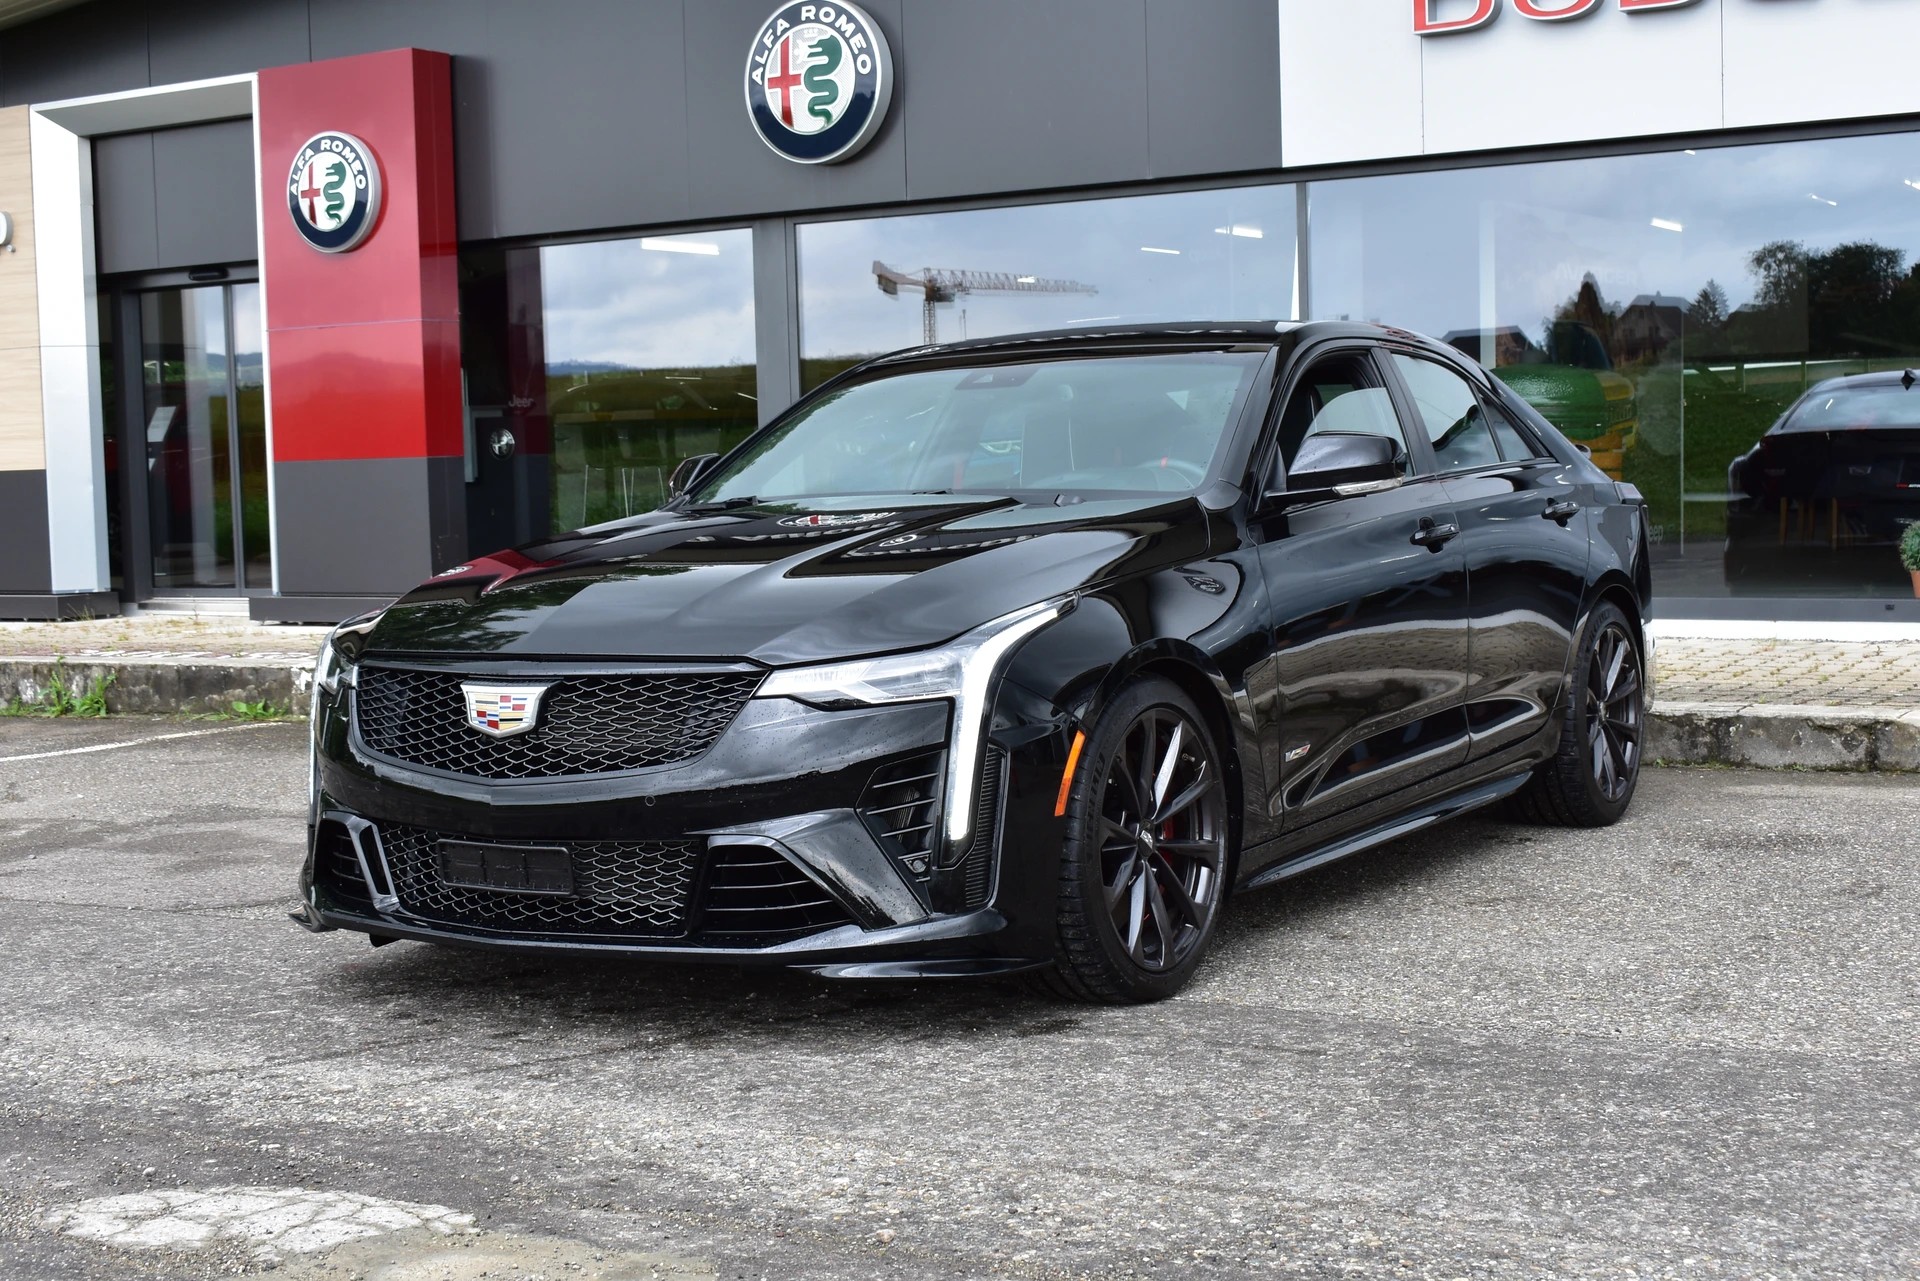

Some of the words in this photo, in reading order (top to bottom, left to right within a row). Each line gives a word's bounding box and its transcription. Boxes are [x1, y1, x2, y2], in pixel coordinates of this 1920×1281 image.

[752, 18, 790, 86] ALFA
[801, 5, 872, 75] ROMEO
[290, 148, 315, 196] ALFA
[320, 139, 367, 190] ROMEO
[1648, 525, 1664, 546] eep
